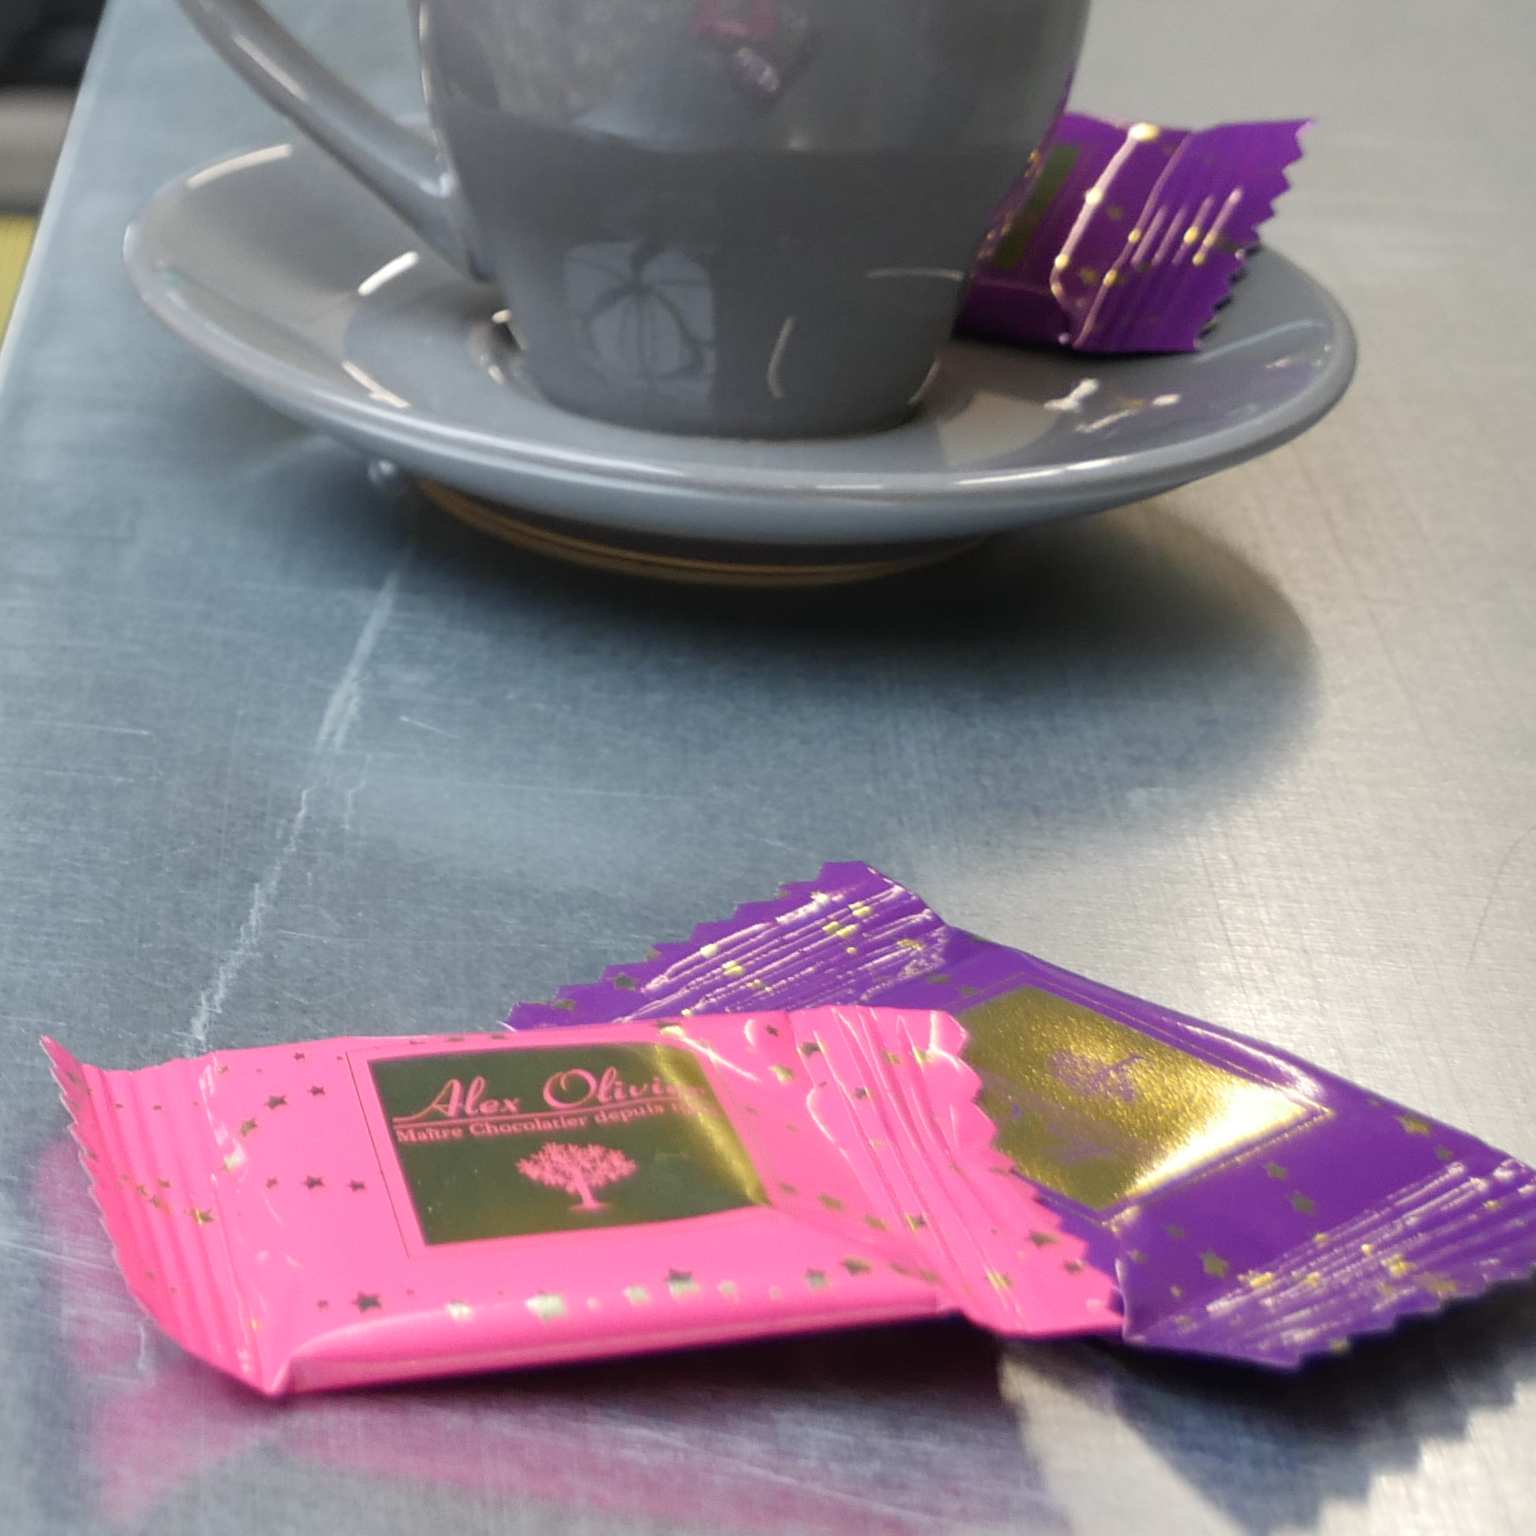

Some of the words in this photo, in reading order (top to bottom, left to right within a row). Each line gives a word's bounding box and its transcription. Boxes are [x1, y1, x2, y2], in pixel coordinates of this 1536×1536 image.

[393, 1076, 521, 1122] Alex
[468, 1107, 589, 1138] Chocolatier
[594, 1103, 665, 1125] depuis
